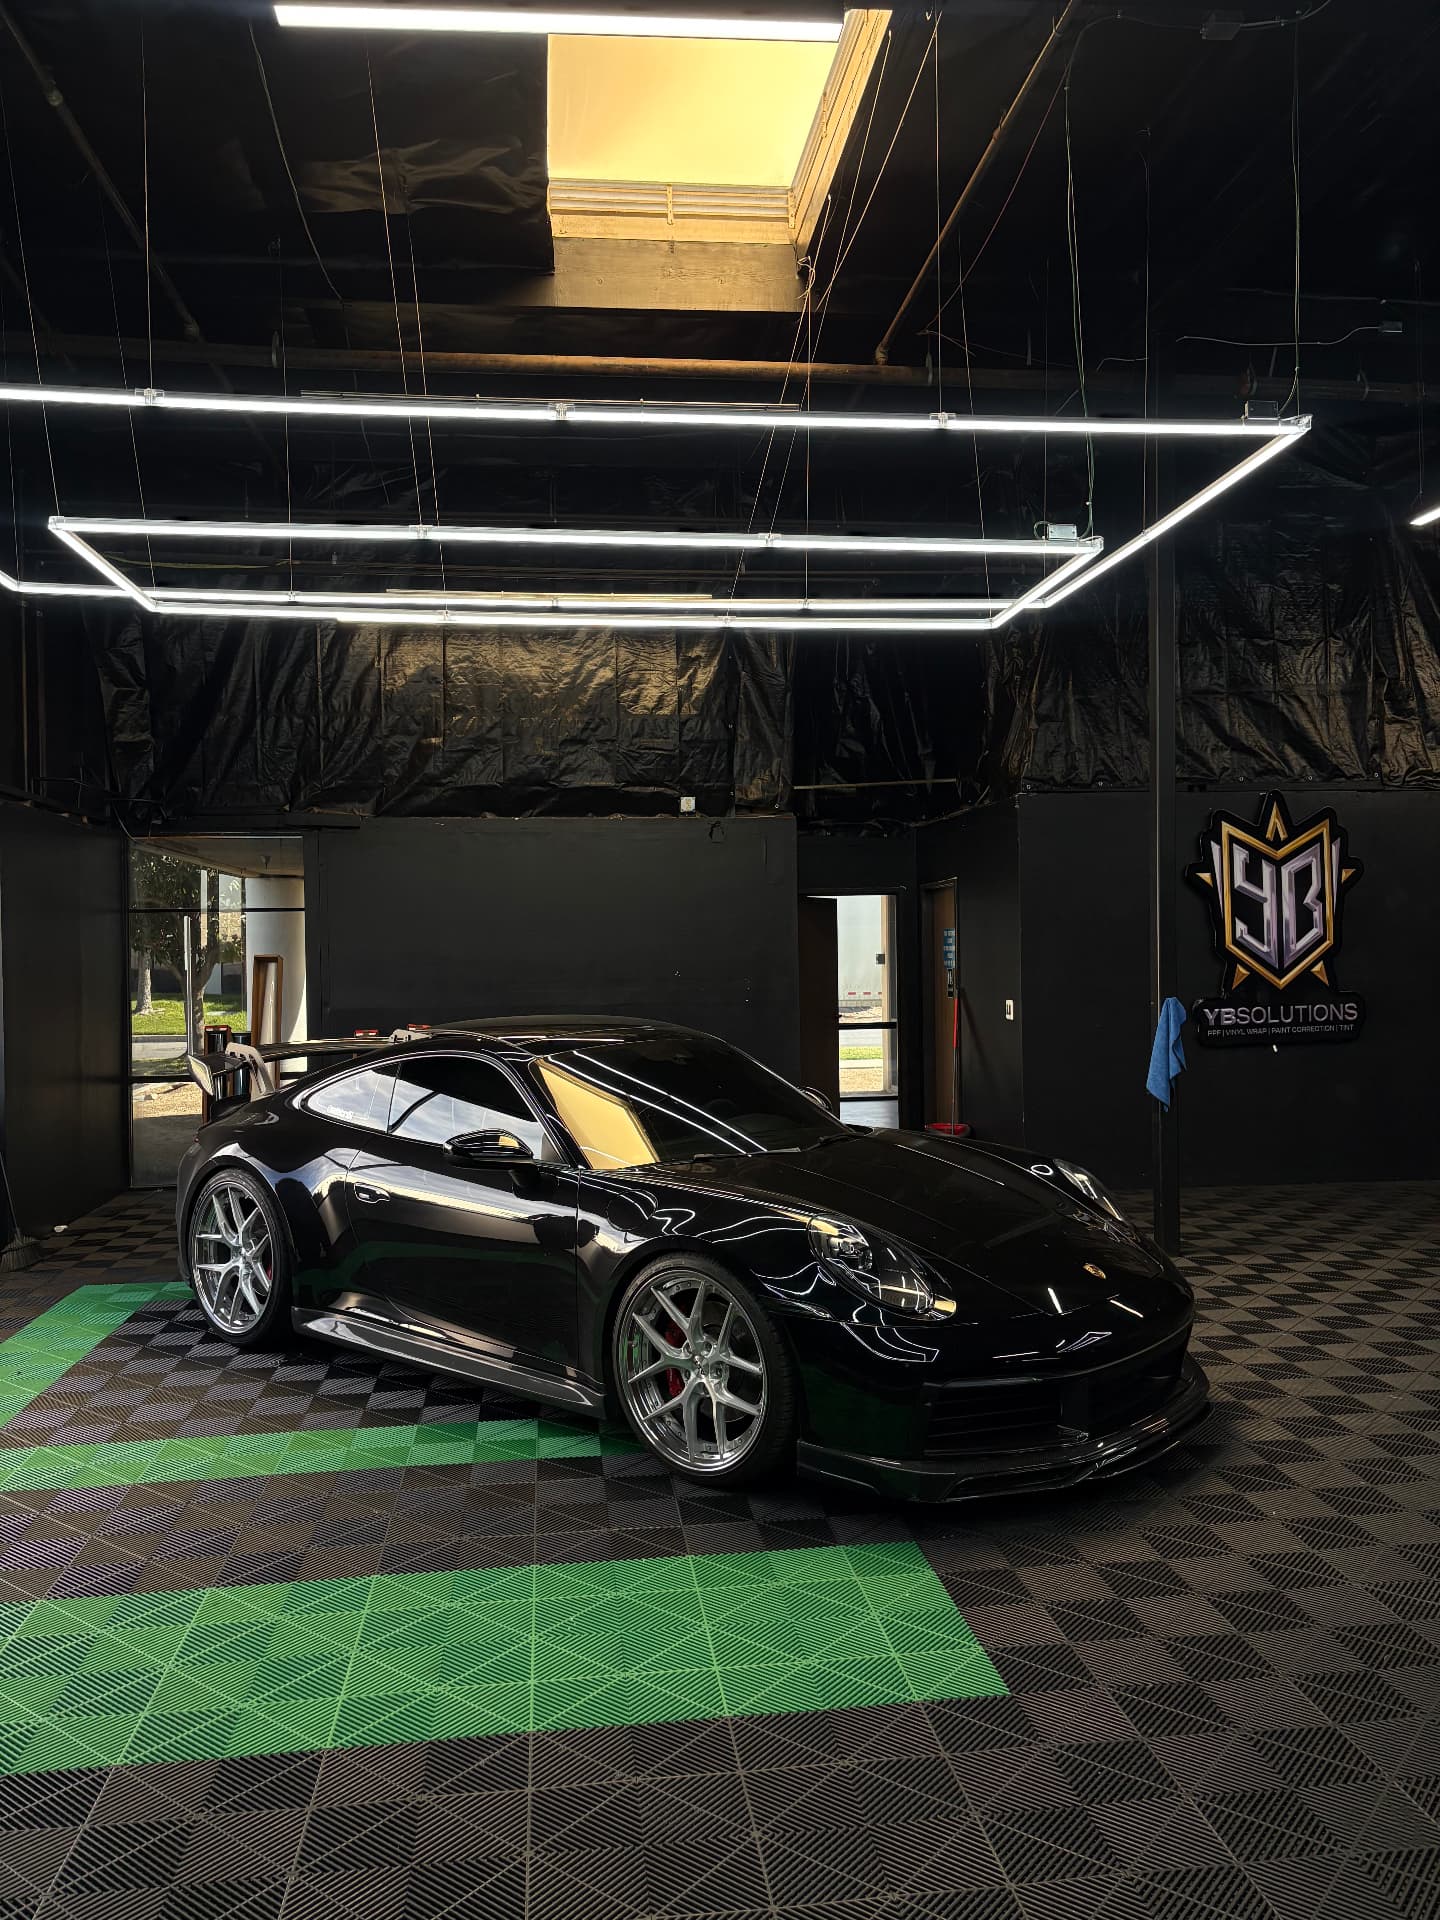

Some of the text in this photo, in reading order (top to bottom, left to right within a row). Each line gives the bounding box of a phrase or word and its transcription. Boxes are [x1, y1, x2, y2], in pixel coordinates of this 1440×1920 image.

[1233, 843, 1323, 969] YB
[1203, 1003, 1358, 1025] YBSOLUTIONS
[1225, 1028, 1245, 1036] VINYL
[1247, 1027, 1267, 1035] WRAP
[1271, 1026, 1291, 1034] PAINT
[1292, 1025, 1334, 1033] CORRECTION
